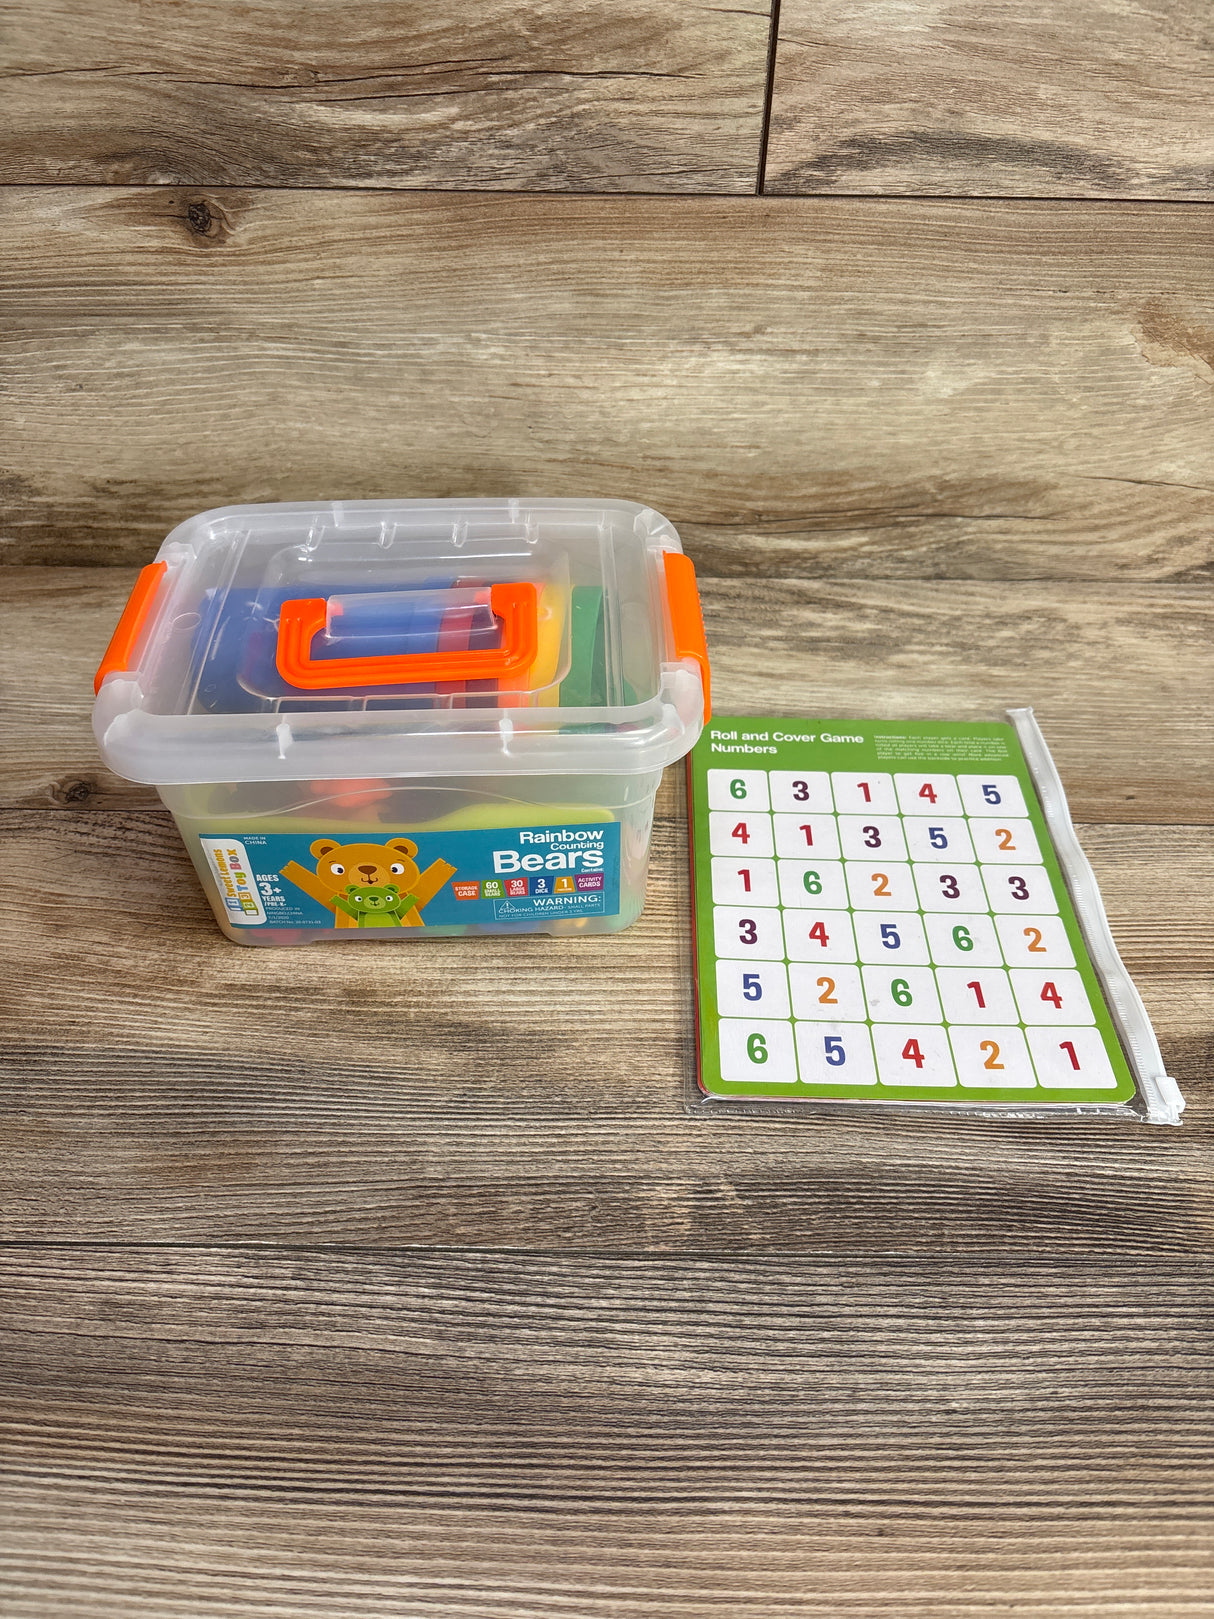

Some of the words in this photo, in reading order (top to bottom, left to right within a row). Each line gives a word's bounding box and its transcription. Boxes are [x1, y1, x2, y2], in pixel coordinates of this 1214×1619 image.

[710, 730, 738, 741] Roll
[741, 731, 769, 742] and
[772, 732, 816, 742] Cover
[820, 733, 864, 744] Game
[711, 743, 778, 754] Numbers
[729, 778, 747, 800] 6
[792, 780, 810, 802] 3
[856, 782, 872, 803] 1
[918, 783, 938, 804] 4
[981, 784, 1002, 805] 5
[519, 829, 604, 844] Rainbow
[731, 822, 751, 845] 4
[799, 824, 814, 847] 1
[862, 825, 882, 849] 3
[928, 827, 948, 850] 5
[995, 828, 1017, 851] 2
[550, 841, 604, 851] Counting
[213, 848, 230, 876] Lemons
[493, 849, 604, 874] Bears
[256, 874, 280, 882] AGES
[485, 881, 499, 889] 60
[510, 880, 523, 888] 30
[537, 878, 546, 889] 3
[561, 878, 568, 889] 1
[579, 881, 601, 889] CARDS
[737, 868, 752, 893] 1
[803, 870, 823, 895] 6
[871, 872, 892, 897] 2
[939, 874, 961, 899] 3
[1007, 876, 1030, 901] 3
[221, 876, 237, 898] Sweet
[259, 882, 282, 896] 3+
[533, 894, 601, 907] WARNING:
[738, 918, 758, 945] 3
[808, 921, 830, 948] 4
[879, 923, 901, 950] 5
[952, 925, 974, 952] 6
[1023, 927, 1047, 953] 2
[742, 973, 763, 1002] 5
[816, 976, 839, 1004] 2
[890, 978, 913, 1007] 6
[966, 981, 986, 1009] 1
[1040, 981, 1063, 1010] 4
[746, 1032, 769, 1065] 6
[823, 1036, 846, 1067] 5
[901, 1038, 926, 1069] 4
[979, 1040, 1005, 1070] 2
[1058, 1041, 1081, 1071] 1
